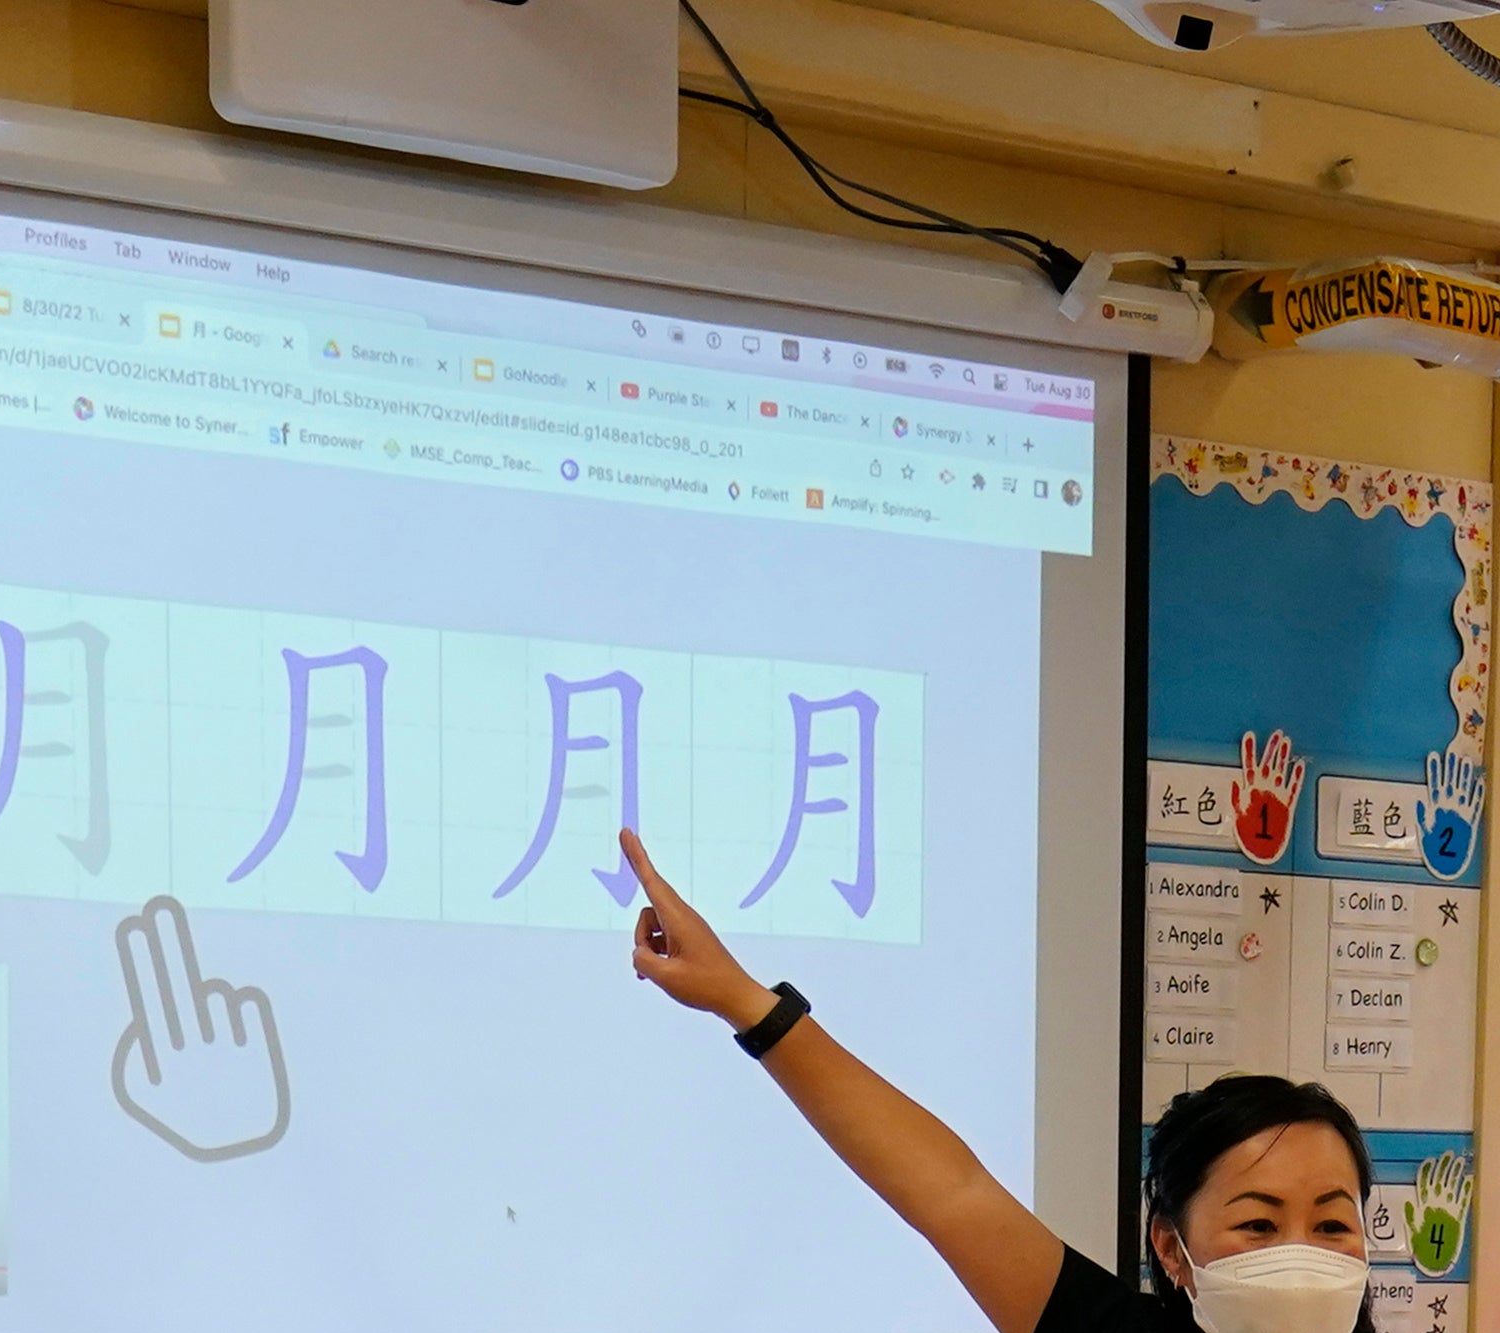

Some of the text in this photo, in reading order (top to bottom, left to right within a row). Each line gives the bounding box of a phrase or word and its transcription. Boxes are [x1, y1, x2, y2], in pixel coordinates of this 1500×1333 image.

[25, 226, 87, 252] Profiles
[114, 240, 141, 260] Tab
[168, 248, 231, 273] Window
[256, 262, 291, 284] Help
[22, 298, 82, 321] 8/30/22
[1285, 264, 1430, 334] CONDENSATE
[351, 345, 398, 367] Search
[648, 386, 687, 408] Purple
[1024, 376, 1092, 402] Tue Aug 30
[104, 404, 172, 429] Welcome
[175, 411, 191, 429] to
[786, 405, 809, 422] The
[299, 428, 365, 452] Empower
[916, 423, 963, 446] Synergy
[588, 465, 709, 495] PBS LearningMedia
[751, 485, 790, 505] Follett
[226, 645, 388, 893] 月
[492, 670, 643, 908] 月
[739, 689, 879, 919] 月
[1159, 785, 1222, 826] 紅色
[1254, 803, 1272, 840] 1
[1350, 798, 1407, 840] 藍色
[1438, 827, 1457, 858] 2
[1158, 876, 1239, 900] Alexandra
[1348, 892, 1386, 912] Colin
[1391, 894, 1408, 913] D.
[1167, 925, 1224, 952] Angela
[1346, 941, 1384, 961] Colin
[1389, 945, 1406, 961] Z.
[1167, 976, 1210, 994] Aoife
[1336, 989, 1403, 1008] 7 Declan
[1165, 1027, 1215, 1047] Claire
[1332, 1038, 1392, 1065] 8 Henry
[1430, 1223, 1446, 1260] 4
